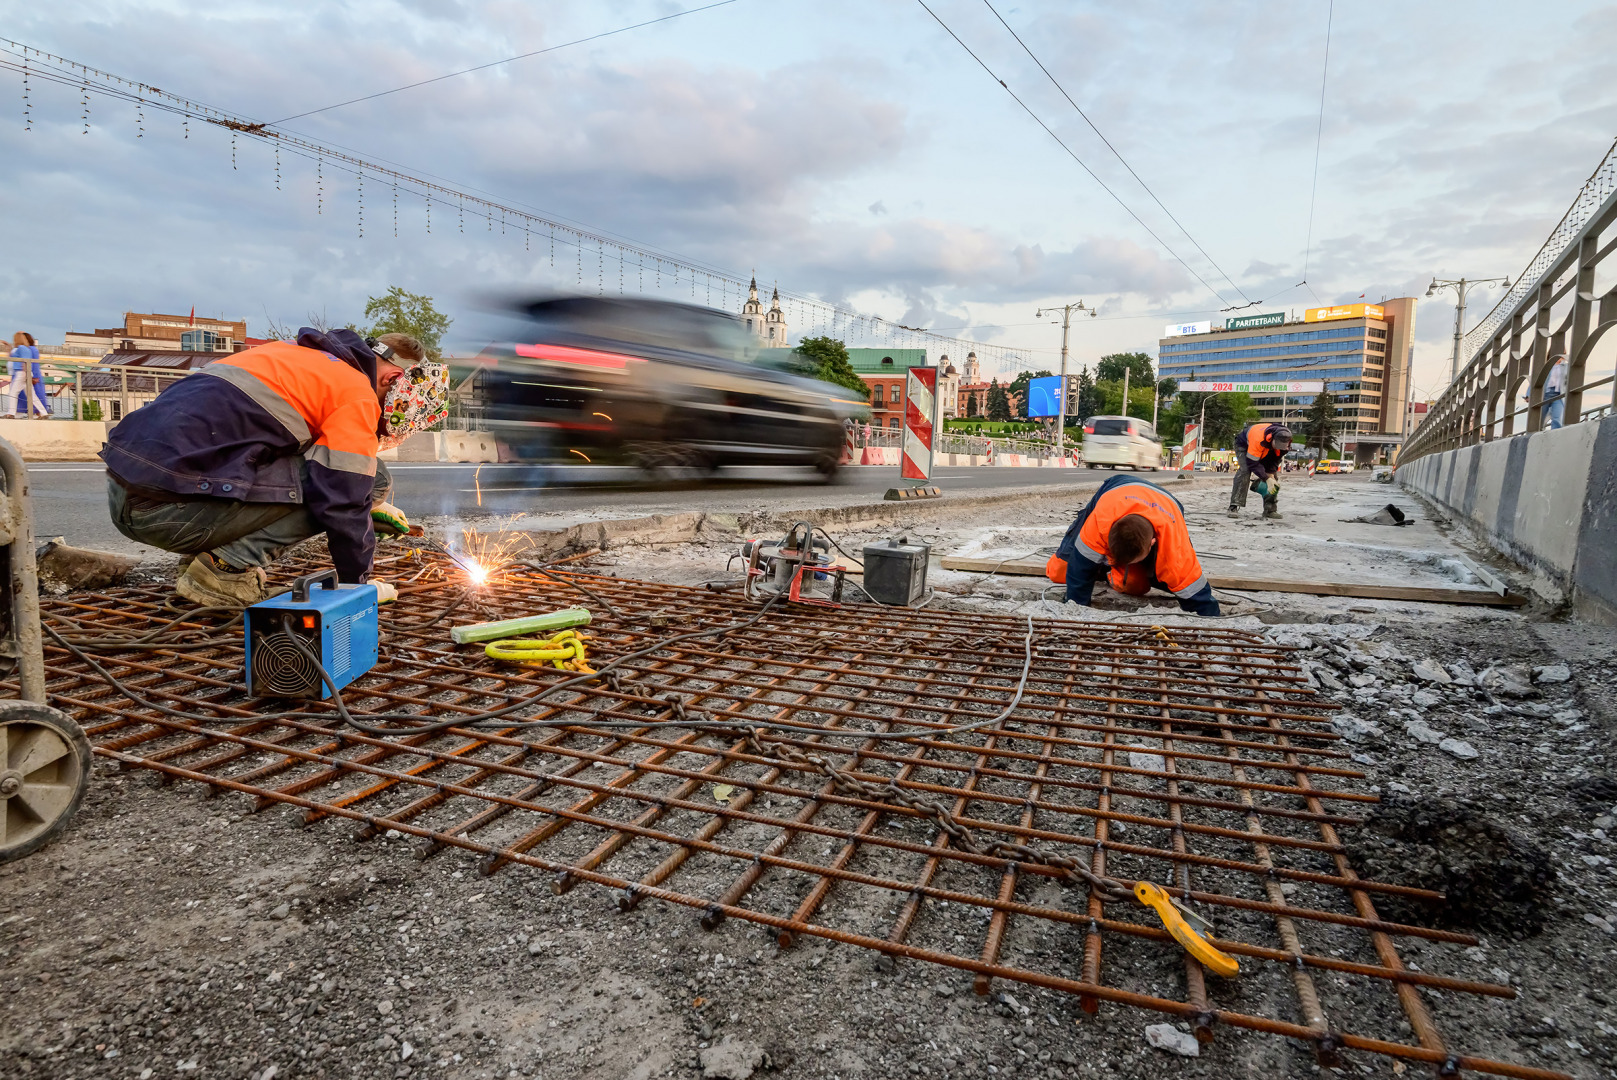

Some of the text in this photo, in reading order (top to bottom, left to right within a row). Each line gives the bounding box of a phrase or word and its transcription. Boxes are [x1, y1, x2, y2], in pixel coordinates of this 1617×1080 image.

[1236, 316, 1282, 328] PARITETBANK
[1182, 326, 1196, 334] ВТБ
[1212, 382, 1288, 392] 2024 ГОД КАЧЕСТВА
